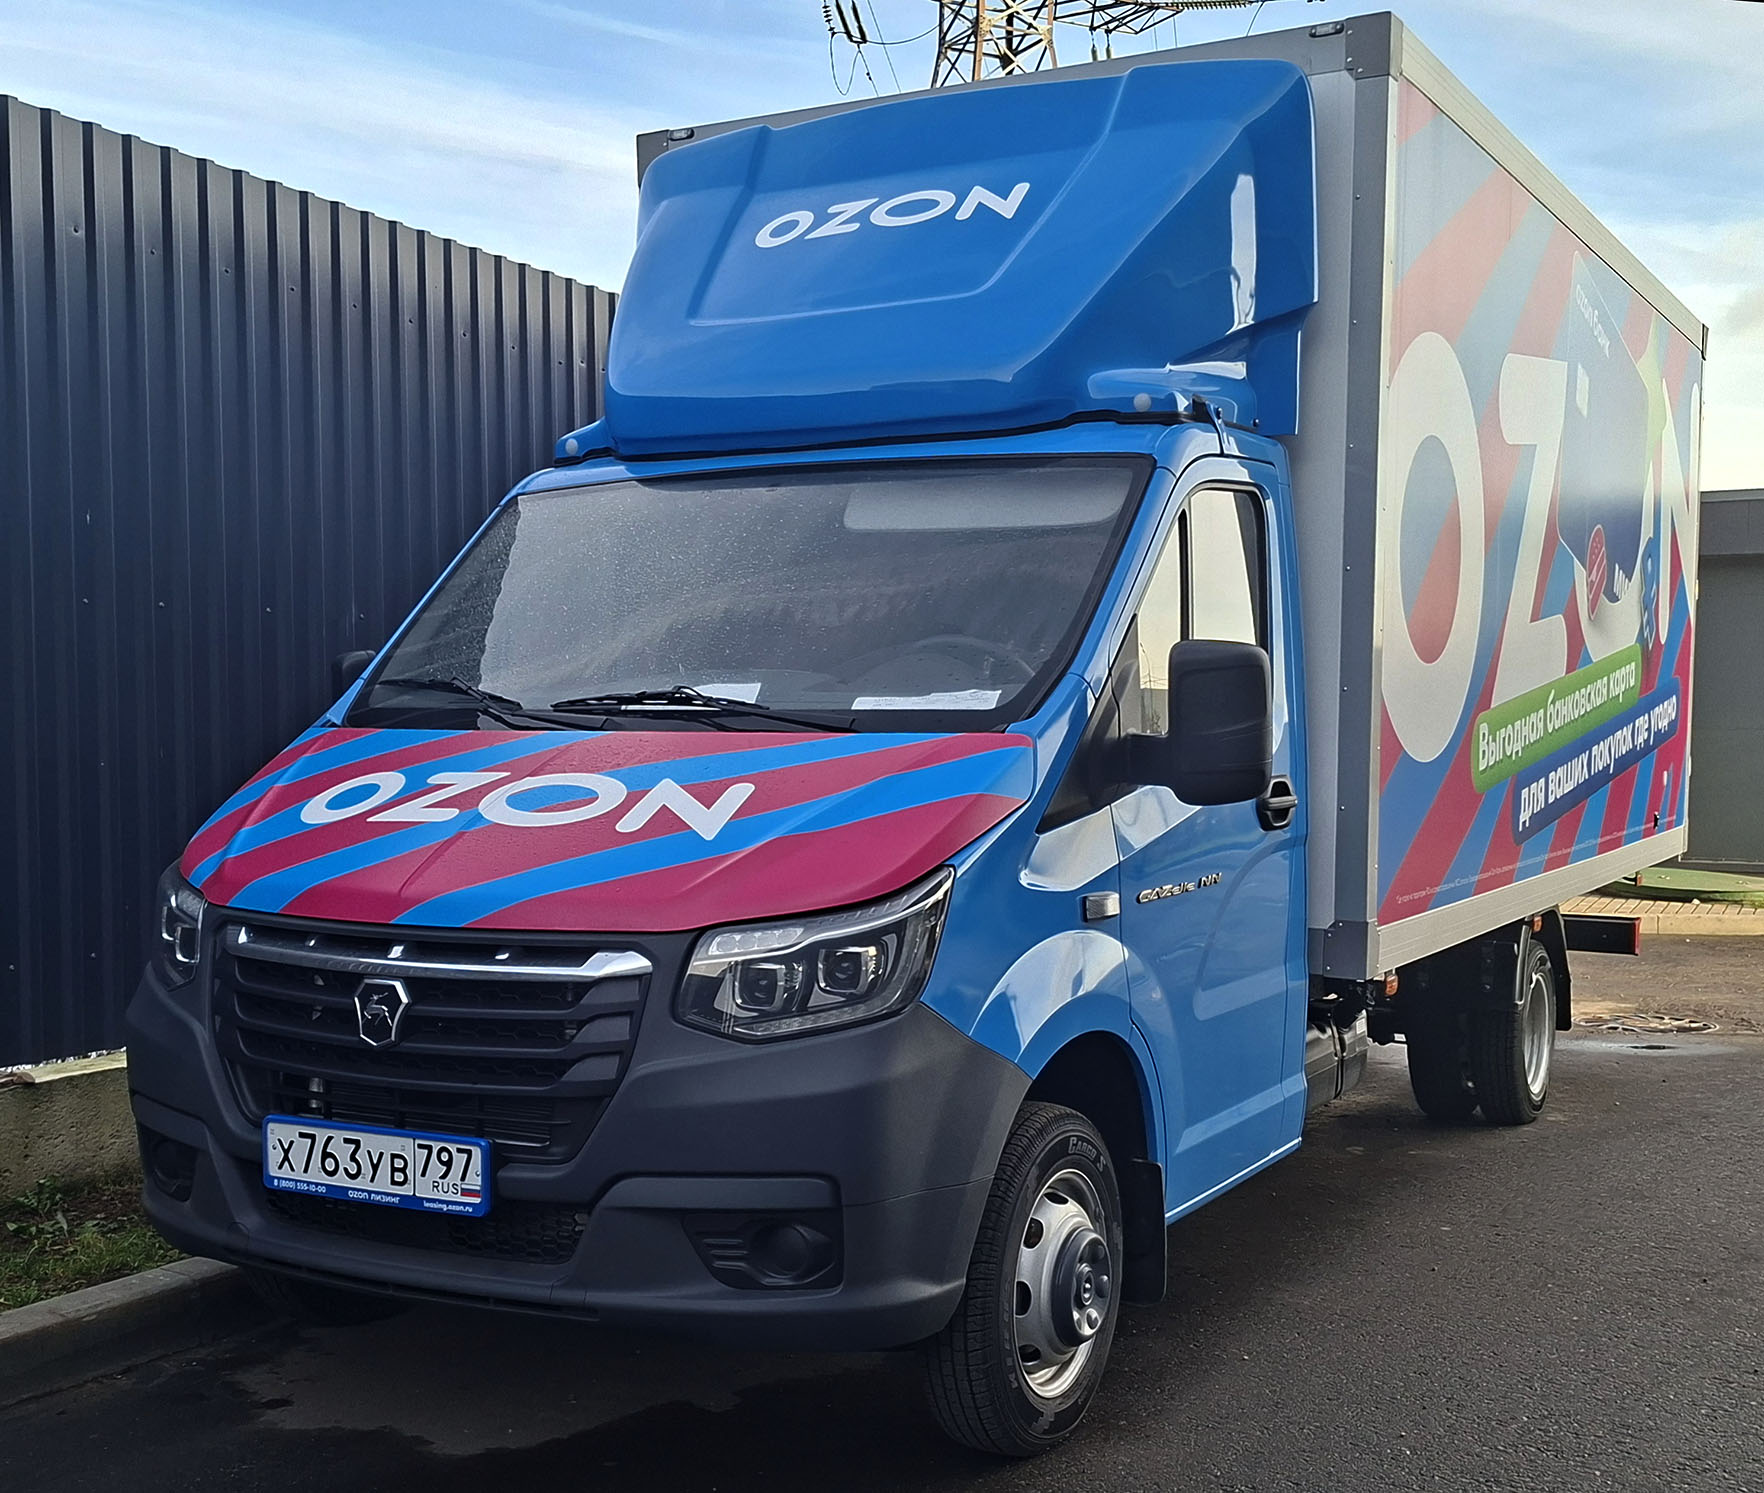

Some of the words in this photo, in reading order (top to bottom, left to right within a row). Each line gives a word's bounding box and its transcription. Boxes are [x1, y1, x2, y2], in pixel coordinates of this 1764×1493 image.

[755, 182, 1031, 248] OZON
[1478, 708, 1545, 772] Выгодная
[1546, 676, 1608, 733] банковская
[1609, 661, 1636, 704] карта
[1518, 776, 1546, 832] для
[1547, 750, 1590, 804] ваших
[1590, 722, 1633, 775] покупок
[1634, 712, 1649, 751] где
[1649, 694, 1677, 746] угодно
[300, 771, 756, 841] OZON
[1199, 871, 1222, 888] NN
[416, 1142, 473, 1183] 797
[273, 1178, 279, 1186] 8
[279, 1179, 296, 1190] (800)
[296, 1181, 327, 1194] 555-10-00
[423, 1199, 473, 1213] leasing.ozon.ru
[431, 1180, 460, 1196] RUS
